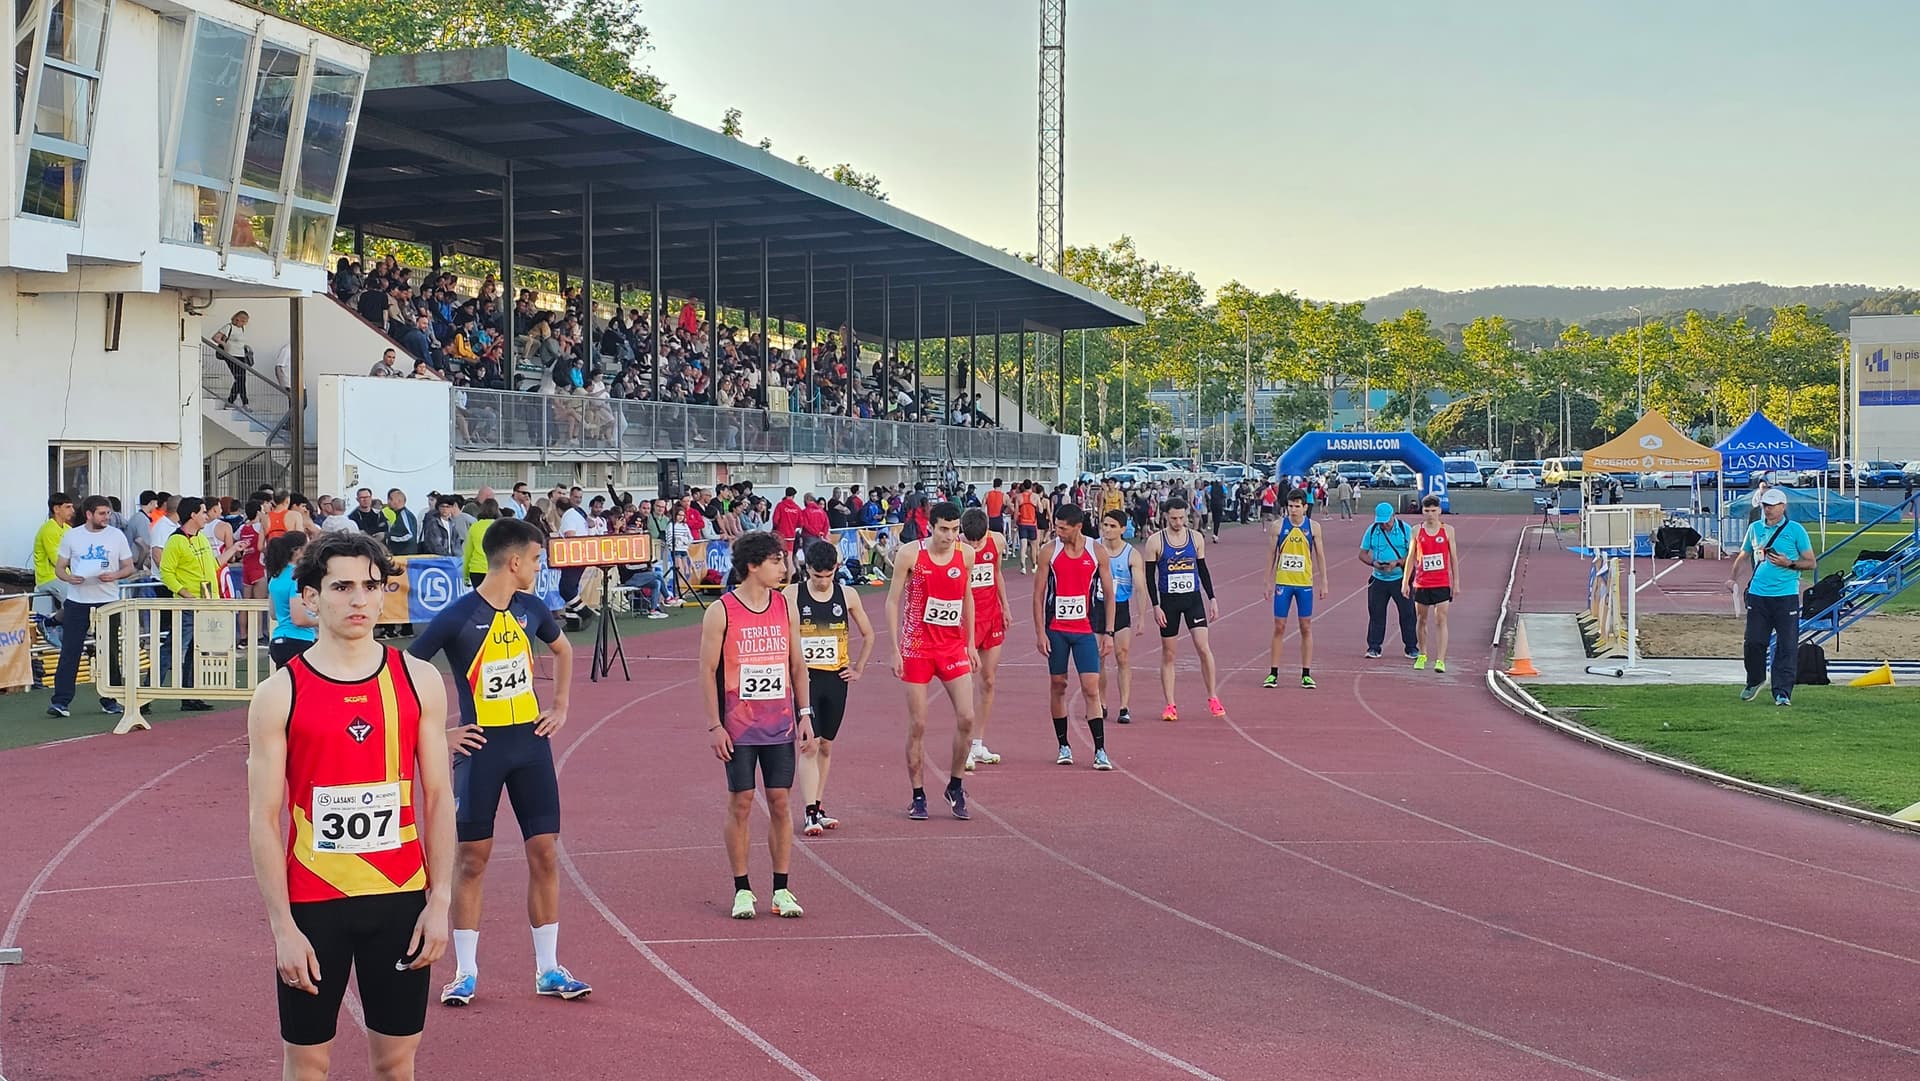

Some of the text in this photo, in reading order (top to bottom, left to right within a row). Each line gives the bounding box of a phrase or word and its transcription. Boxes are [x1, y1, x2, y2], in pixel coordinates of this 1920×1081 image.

[1327, 438, 1400, 450] LASANSI.COM
[1728, 441, 1793, 450] LASANSI
[1659, 457, 1710, 466] TELECOM
[1729, 454, 1795, 469] LASANSI
[1283, 560, 1303, 569] 423
[1171, 580, 1192, 589] 360
[928, 607, 958, 621] 320
[1059, 604, 1083, 615] 370
[493, 630, 520, 645] UCA
[740, 625, 782, 640] TERRA DE
[736, 637, 787, 654] VOLCANS
[804, 647, 835, 659] 323
[488, 669, 527, 693] 344
[745, 677, 782, 692] 324
[333, 795, 357, 804] LASANSI
[321, 809, 393, 840] 307
